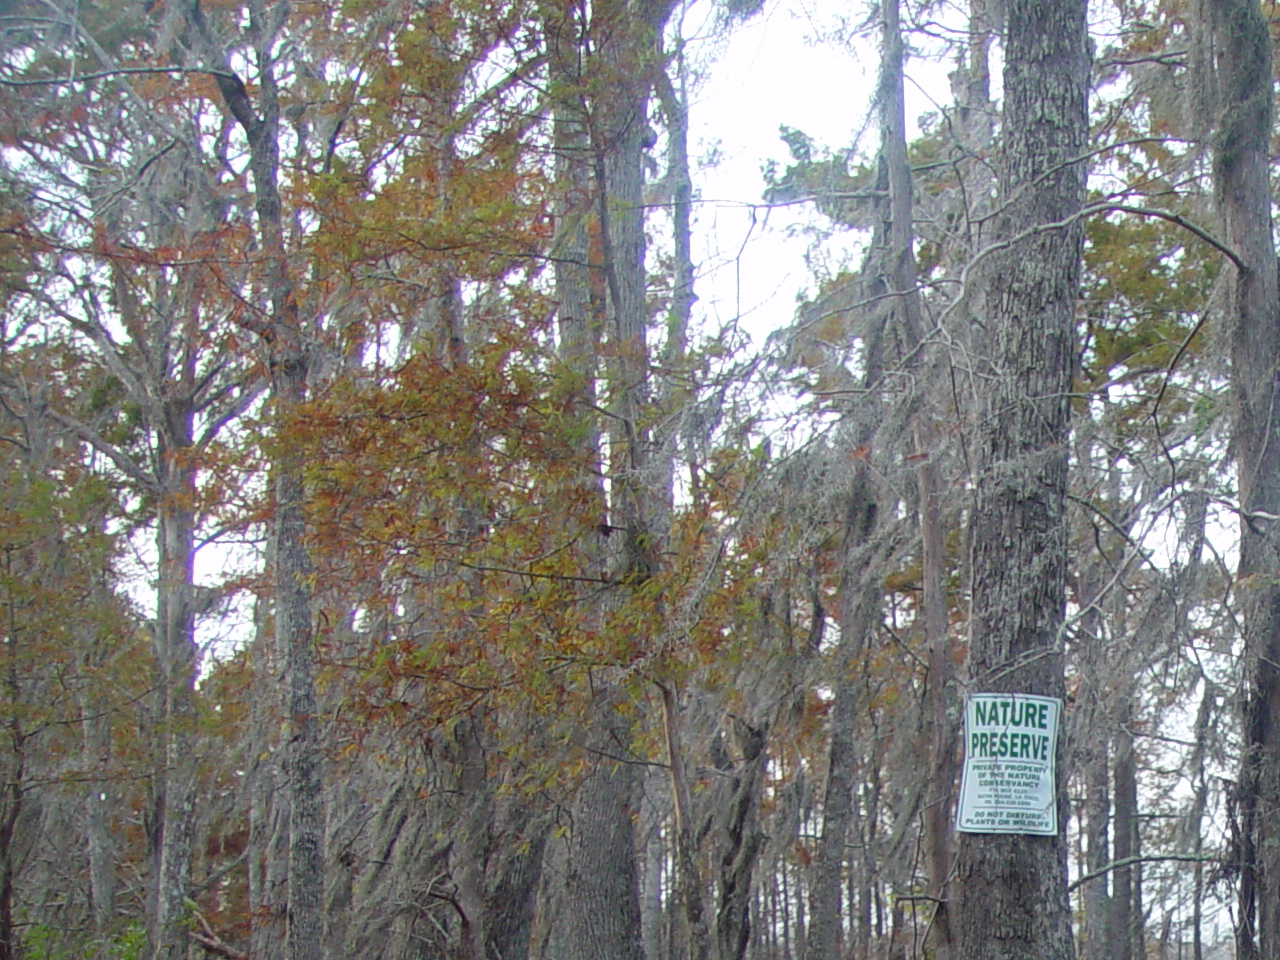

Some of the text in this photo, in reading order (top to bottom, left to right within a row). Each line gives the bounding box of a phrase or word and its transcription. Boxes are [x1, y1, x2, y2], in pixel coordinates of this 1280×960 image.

[975, 700, 1049, 729] NATURE
[971, 732, 1049, 760] PRESERVE
[1004, 764, 1049, 773] PROPERTY
[989, 771, 1005, 779] THE
[1007, 772, 1041, 781] NATURE
[978, 780, 1040, 789] CONSERVANCY
[1012, 820, 1050, 828] WILDLIFE
